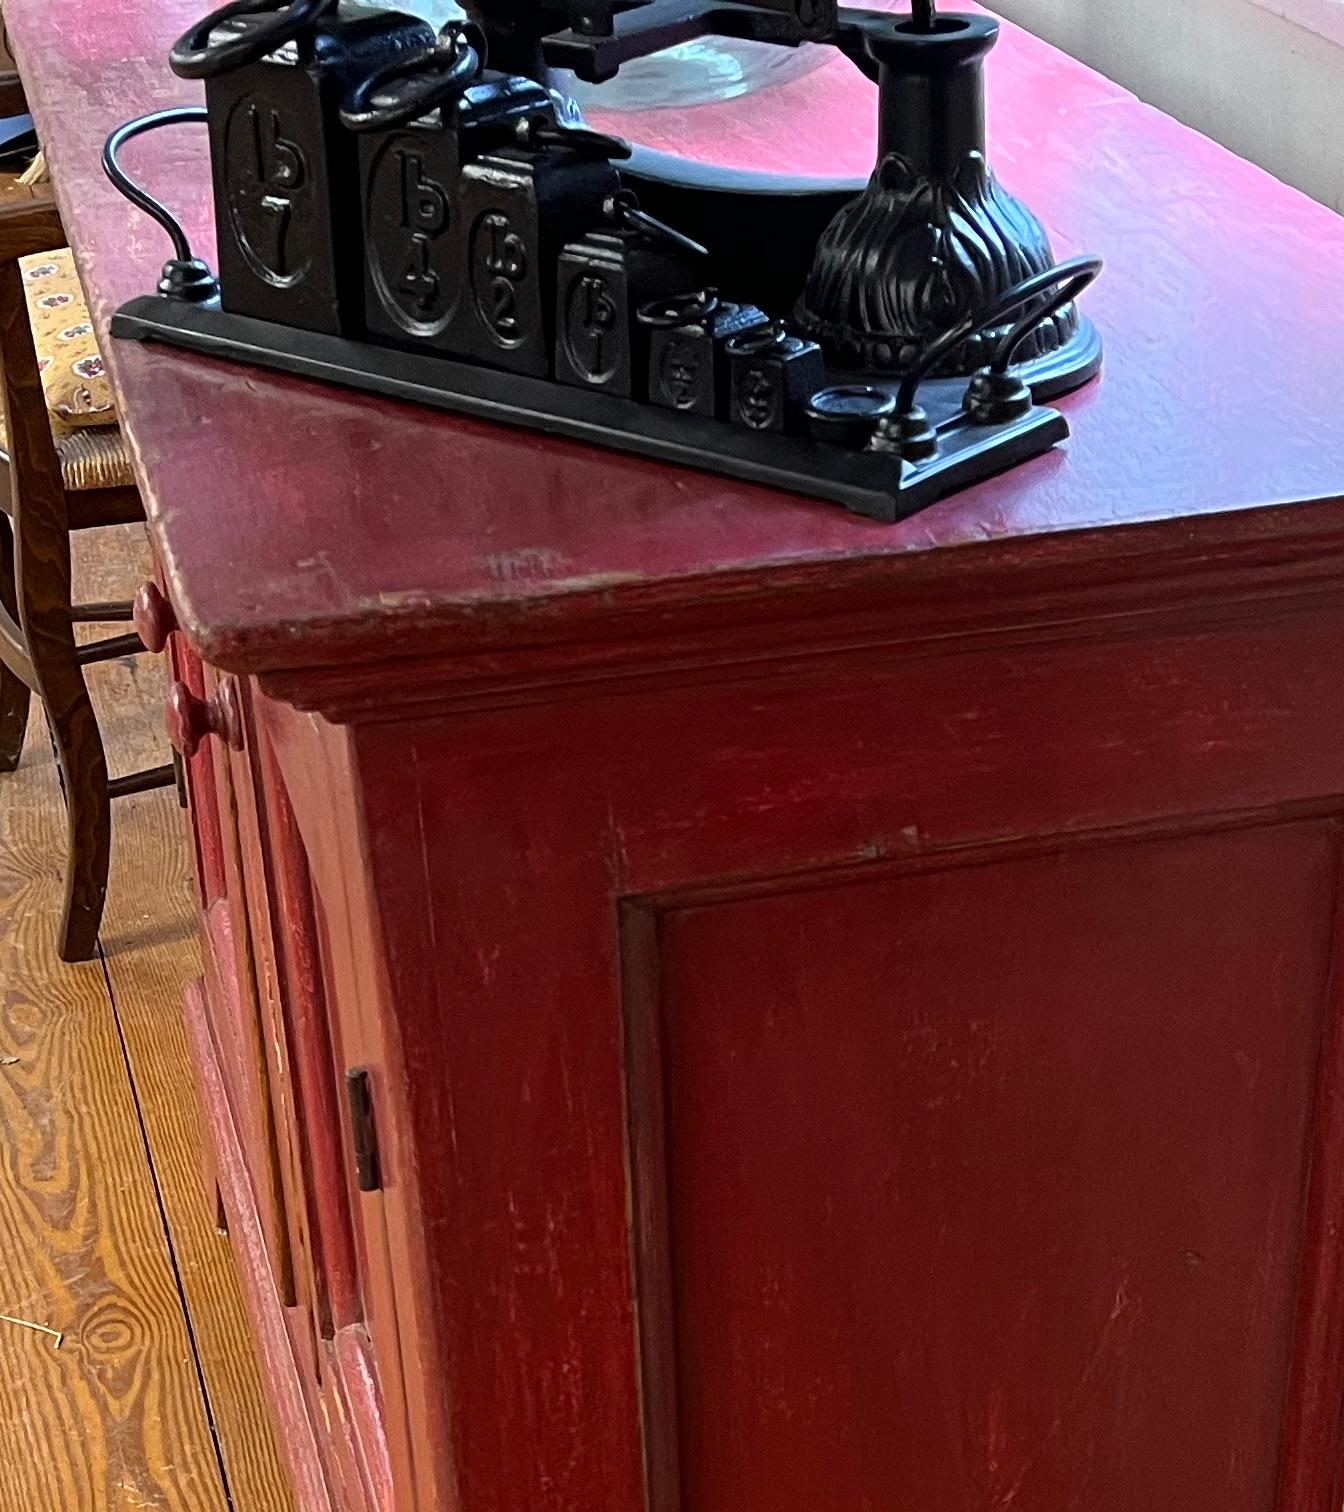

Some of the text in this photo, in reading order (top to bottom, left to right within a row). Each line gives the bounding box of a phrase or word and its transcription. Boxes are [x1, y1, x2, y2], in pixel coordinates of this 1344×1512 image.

[260, 194, 293, 277] 7
[397, 232, 440, 311] 4
[492, 277, 519, 340] 2
